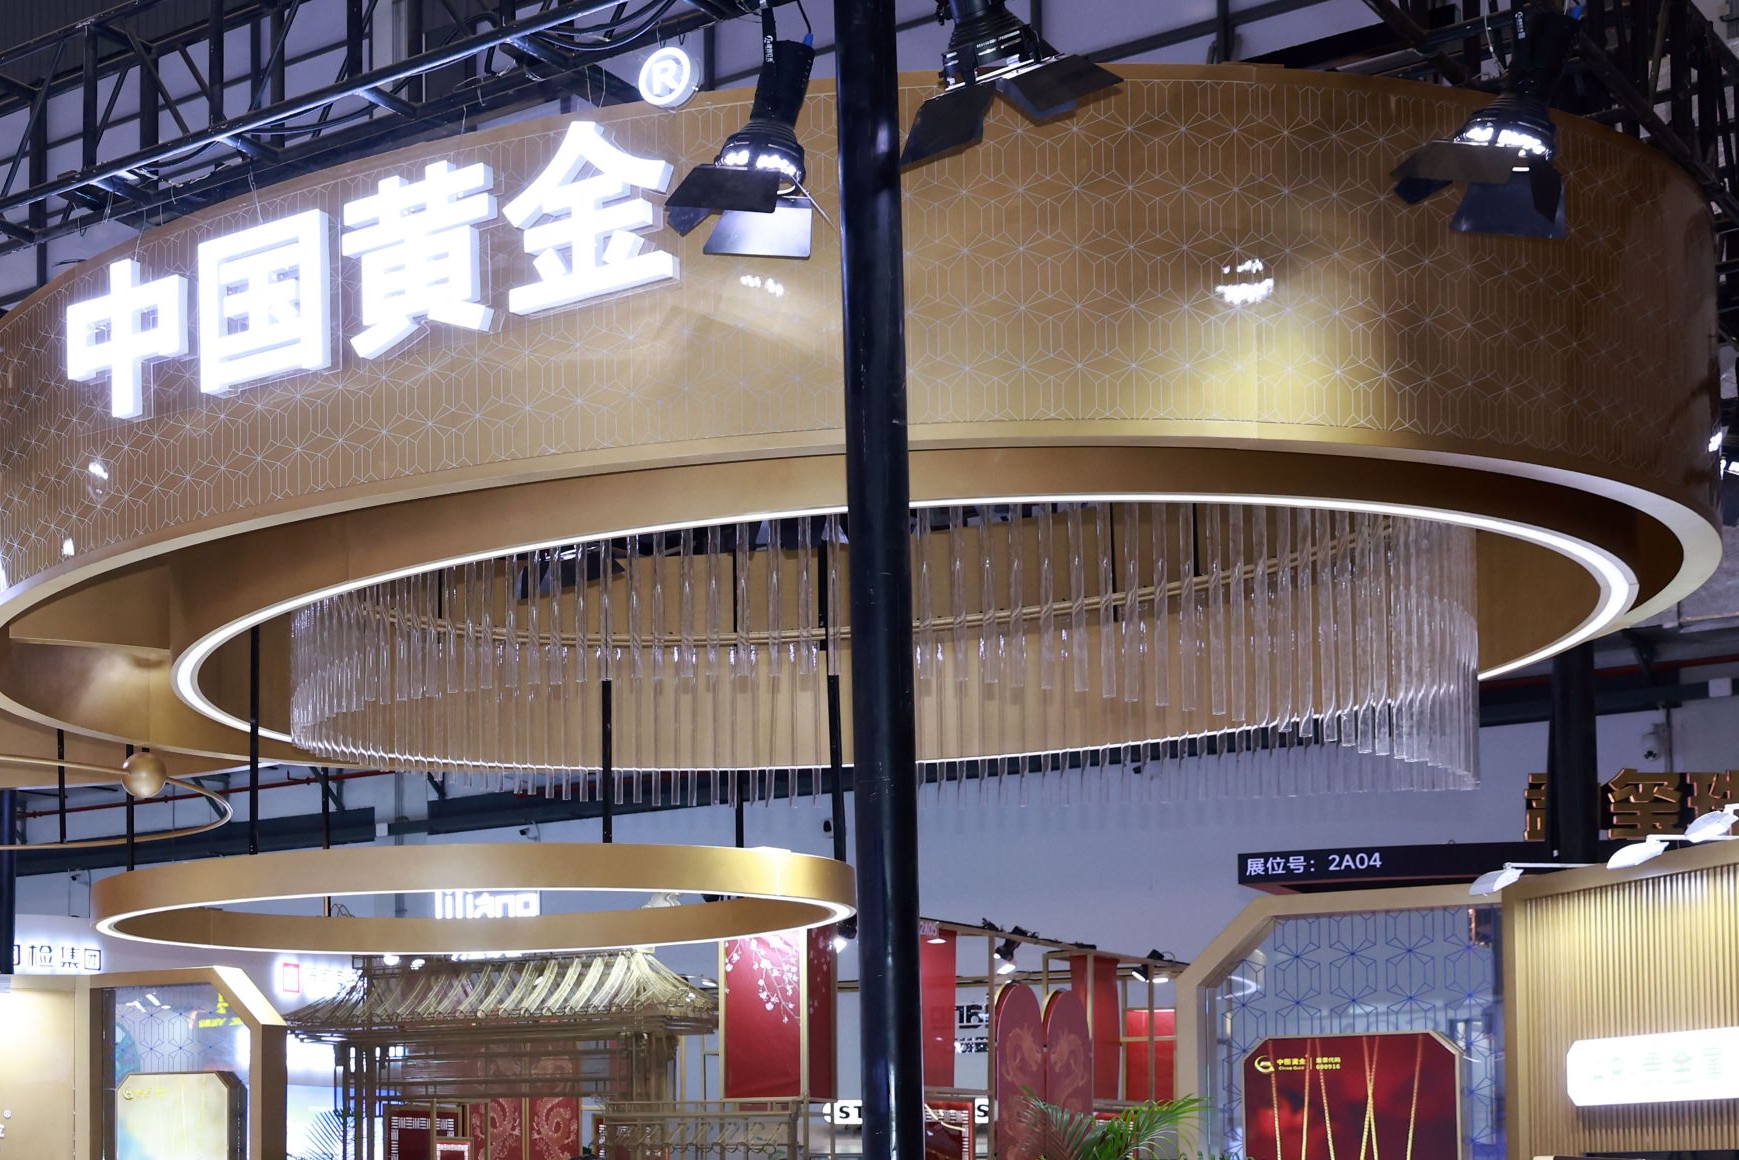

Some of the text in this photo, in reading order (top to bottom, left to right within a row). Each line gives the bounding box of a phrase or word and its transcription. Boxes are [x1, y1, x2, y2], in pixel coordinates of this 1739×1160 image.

[66, 121, 680, 420] 中国黄金
[1328, 852, 1382, 871] 2A04
